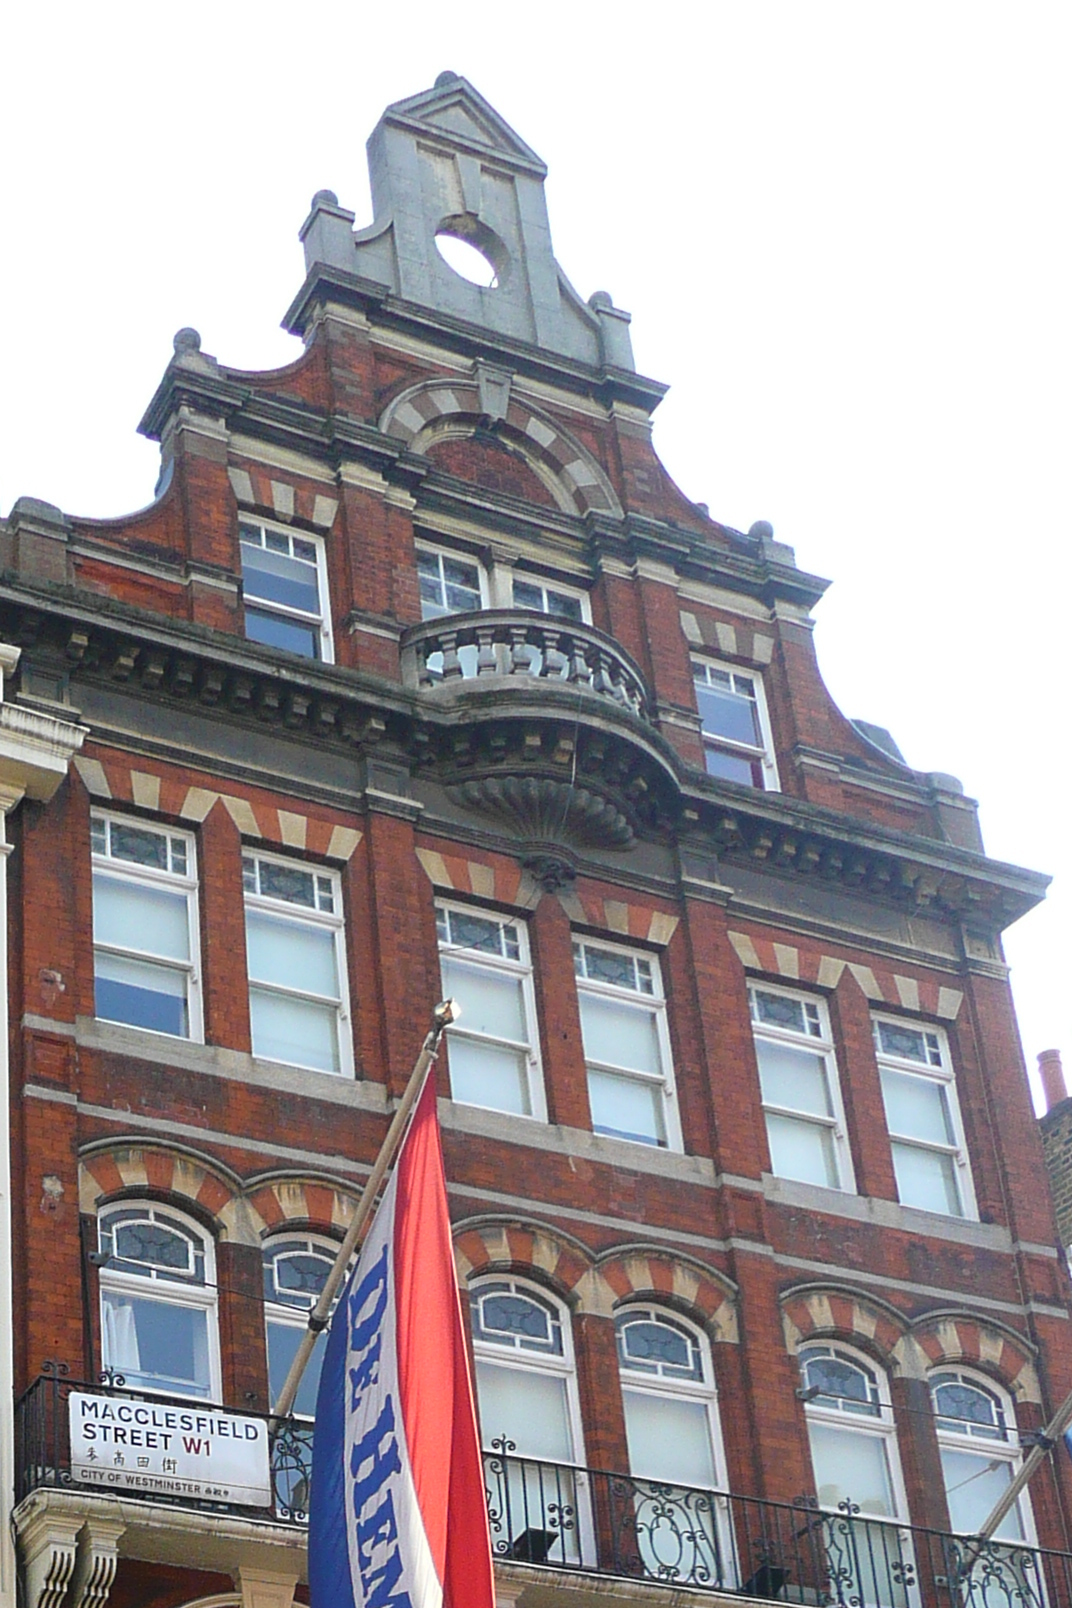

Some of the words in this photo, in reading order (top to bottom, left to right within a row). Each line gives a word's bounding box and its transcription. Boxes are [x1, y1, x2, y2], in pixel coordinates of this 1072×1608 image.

[349, 1243, 388, 1413] DE
[81, 1400, 259, 1440] MACCLESFIELD
[82, 1423, 172, 1450] STREET
[182, 1436, 211, 1456] W1
[81, 1469, 105, 1482] CITY
[108, 1473, 121, 1483] OF
[125, 1475, 201, 1494] WESTMINSTER
